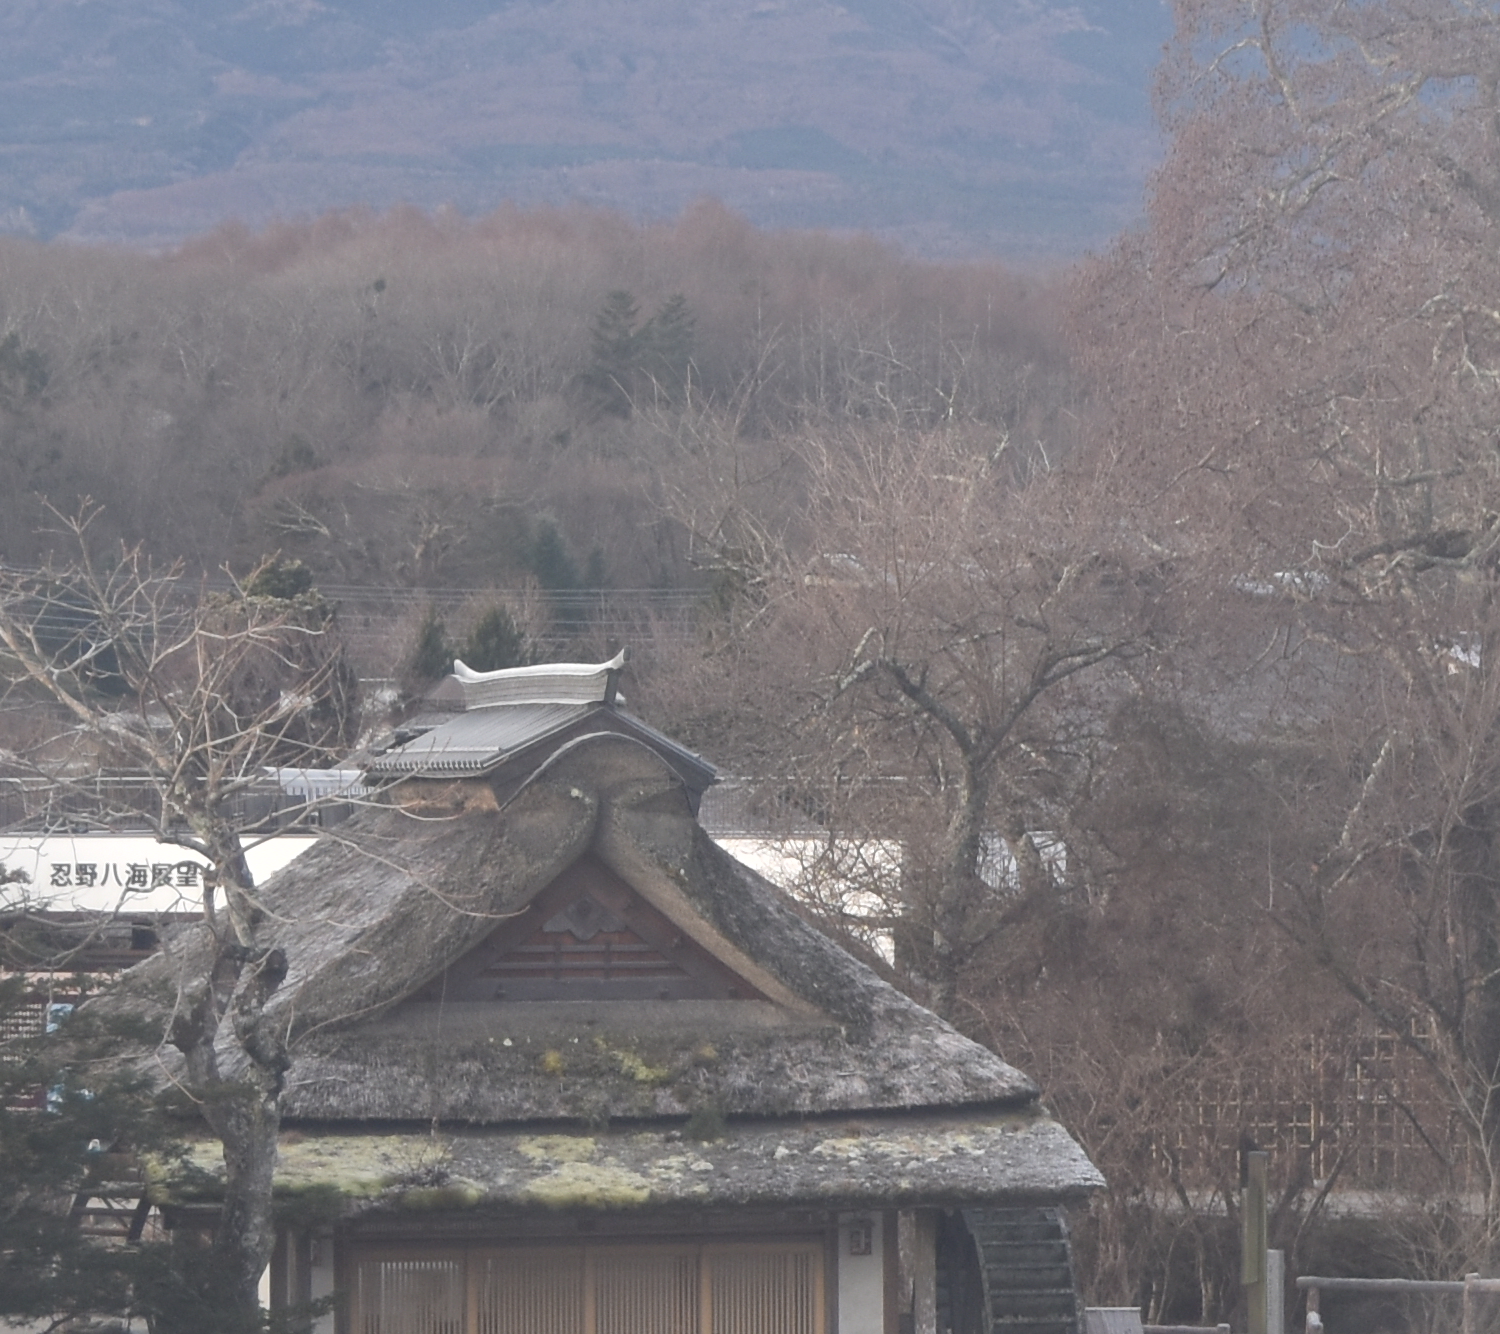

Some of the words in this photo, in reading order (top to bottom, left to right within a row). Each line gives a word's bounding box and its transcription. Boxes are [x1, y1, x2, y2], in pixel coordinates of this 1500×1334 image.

[49, 862, 206, 888] 忍野八海展望
